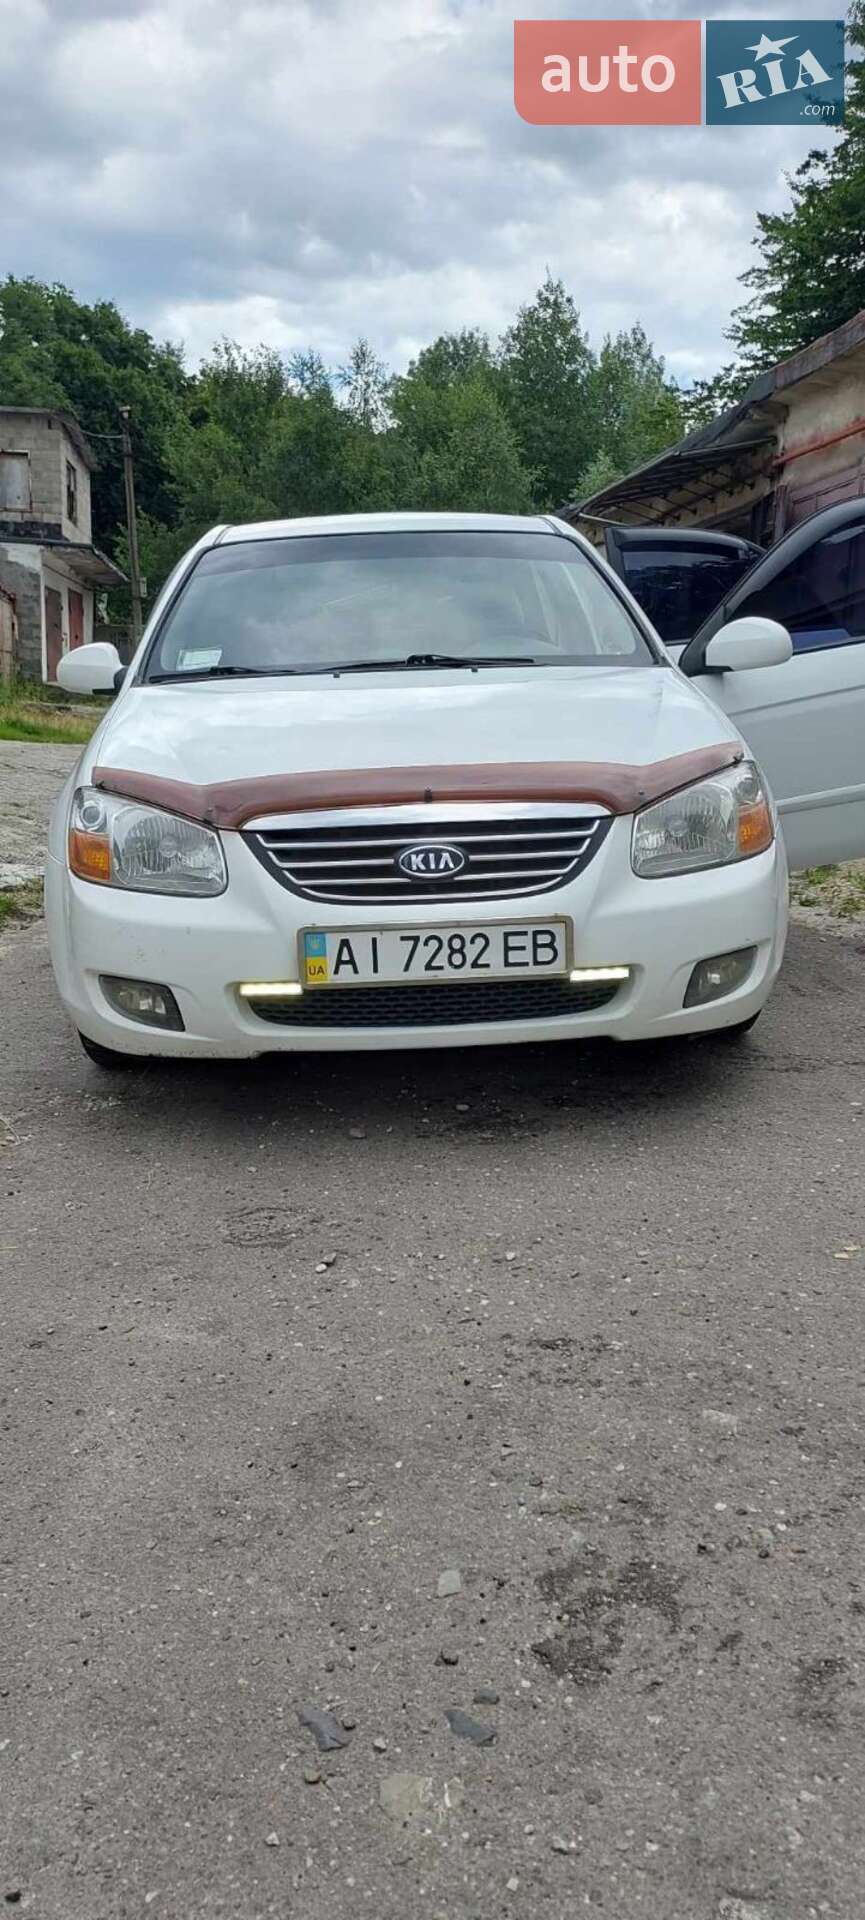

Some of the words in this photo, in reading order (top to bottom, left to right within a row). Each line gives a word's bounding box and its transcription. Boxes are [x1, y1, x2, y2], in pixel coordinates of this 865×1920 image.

[410, 852, 455, 871] KIA
[333, 936, 379, 976] AI
[400, 932, 491, 973] 7282
[503, 929, 559, 968] EB
[308, 965, 325, 977] UA
